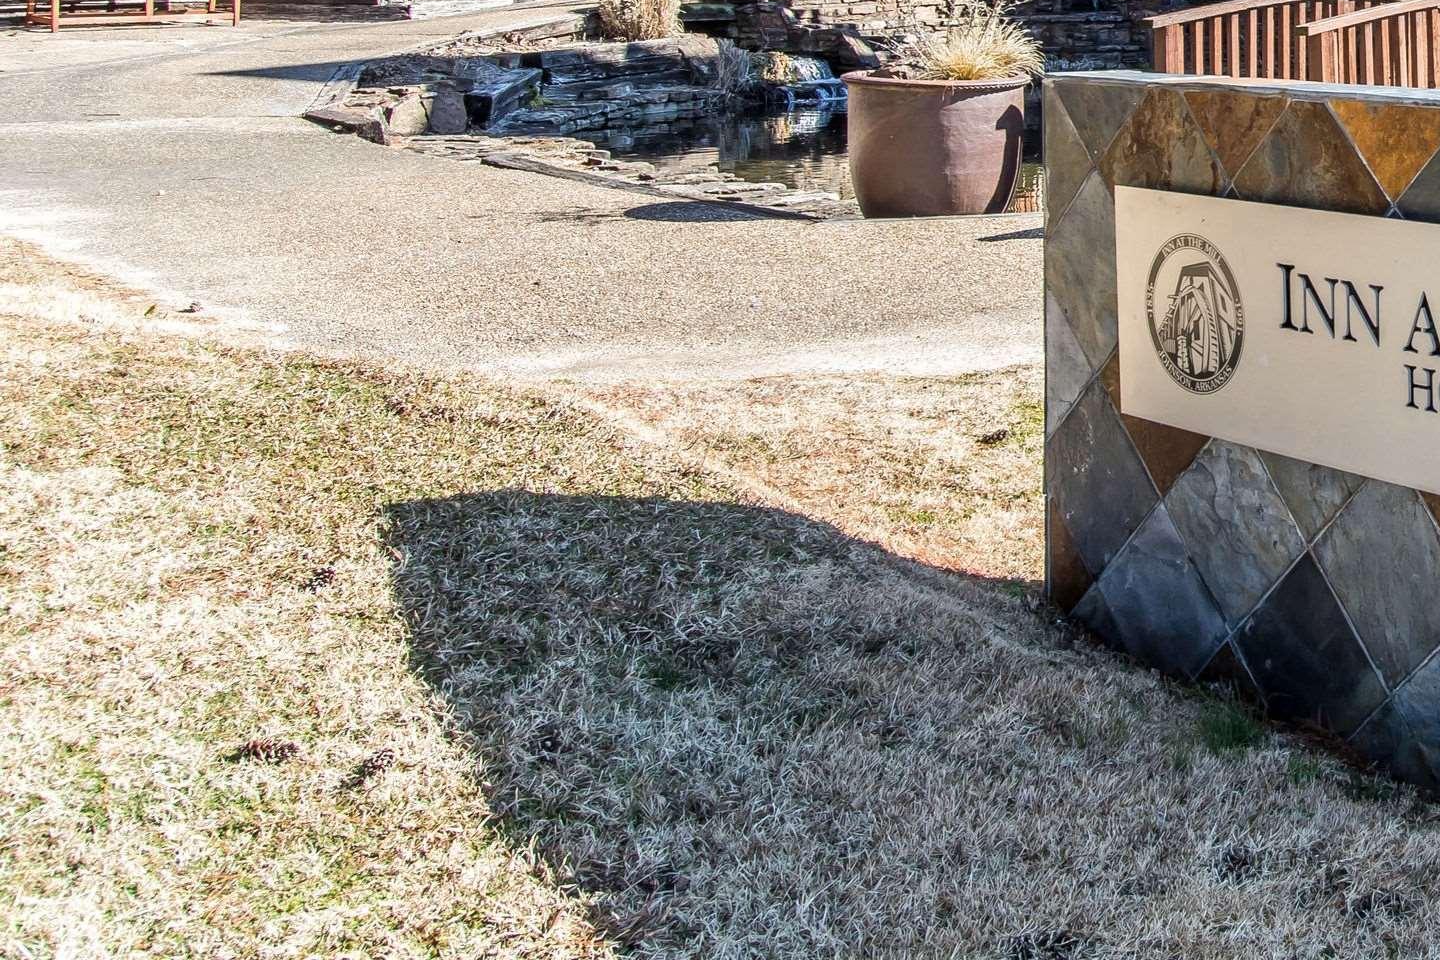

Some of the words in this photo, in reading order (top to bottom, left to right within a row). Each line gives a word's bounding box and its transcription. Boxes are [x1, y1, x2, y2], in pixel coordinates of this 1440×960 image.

[1187, 236, 1205, 250] THE
[1275, 262, 1384, 347] INN
[1195, 365, 1232, 391] ARKANSAS
